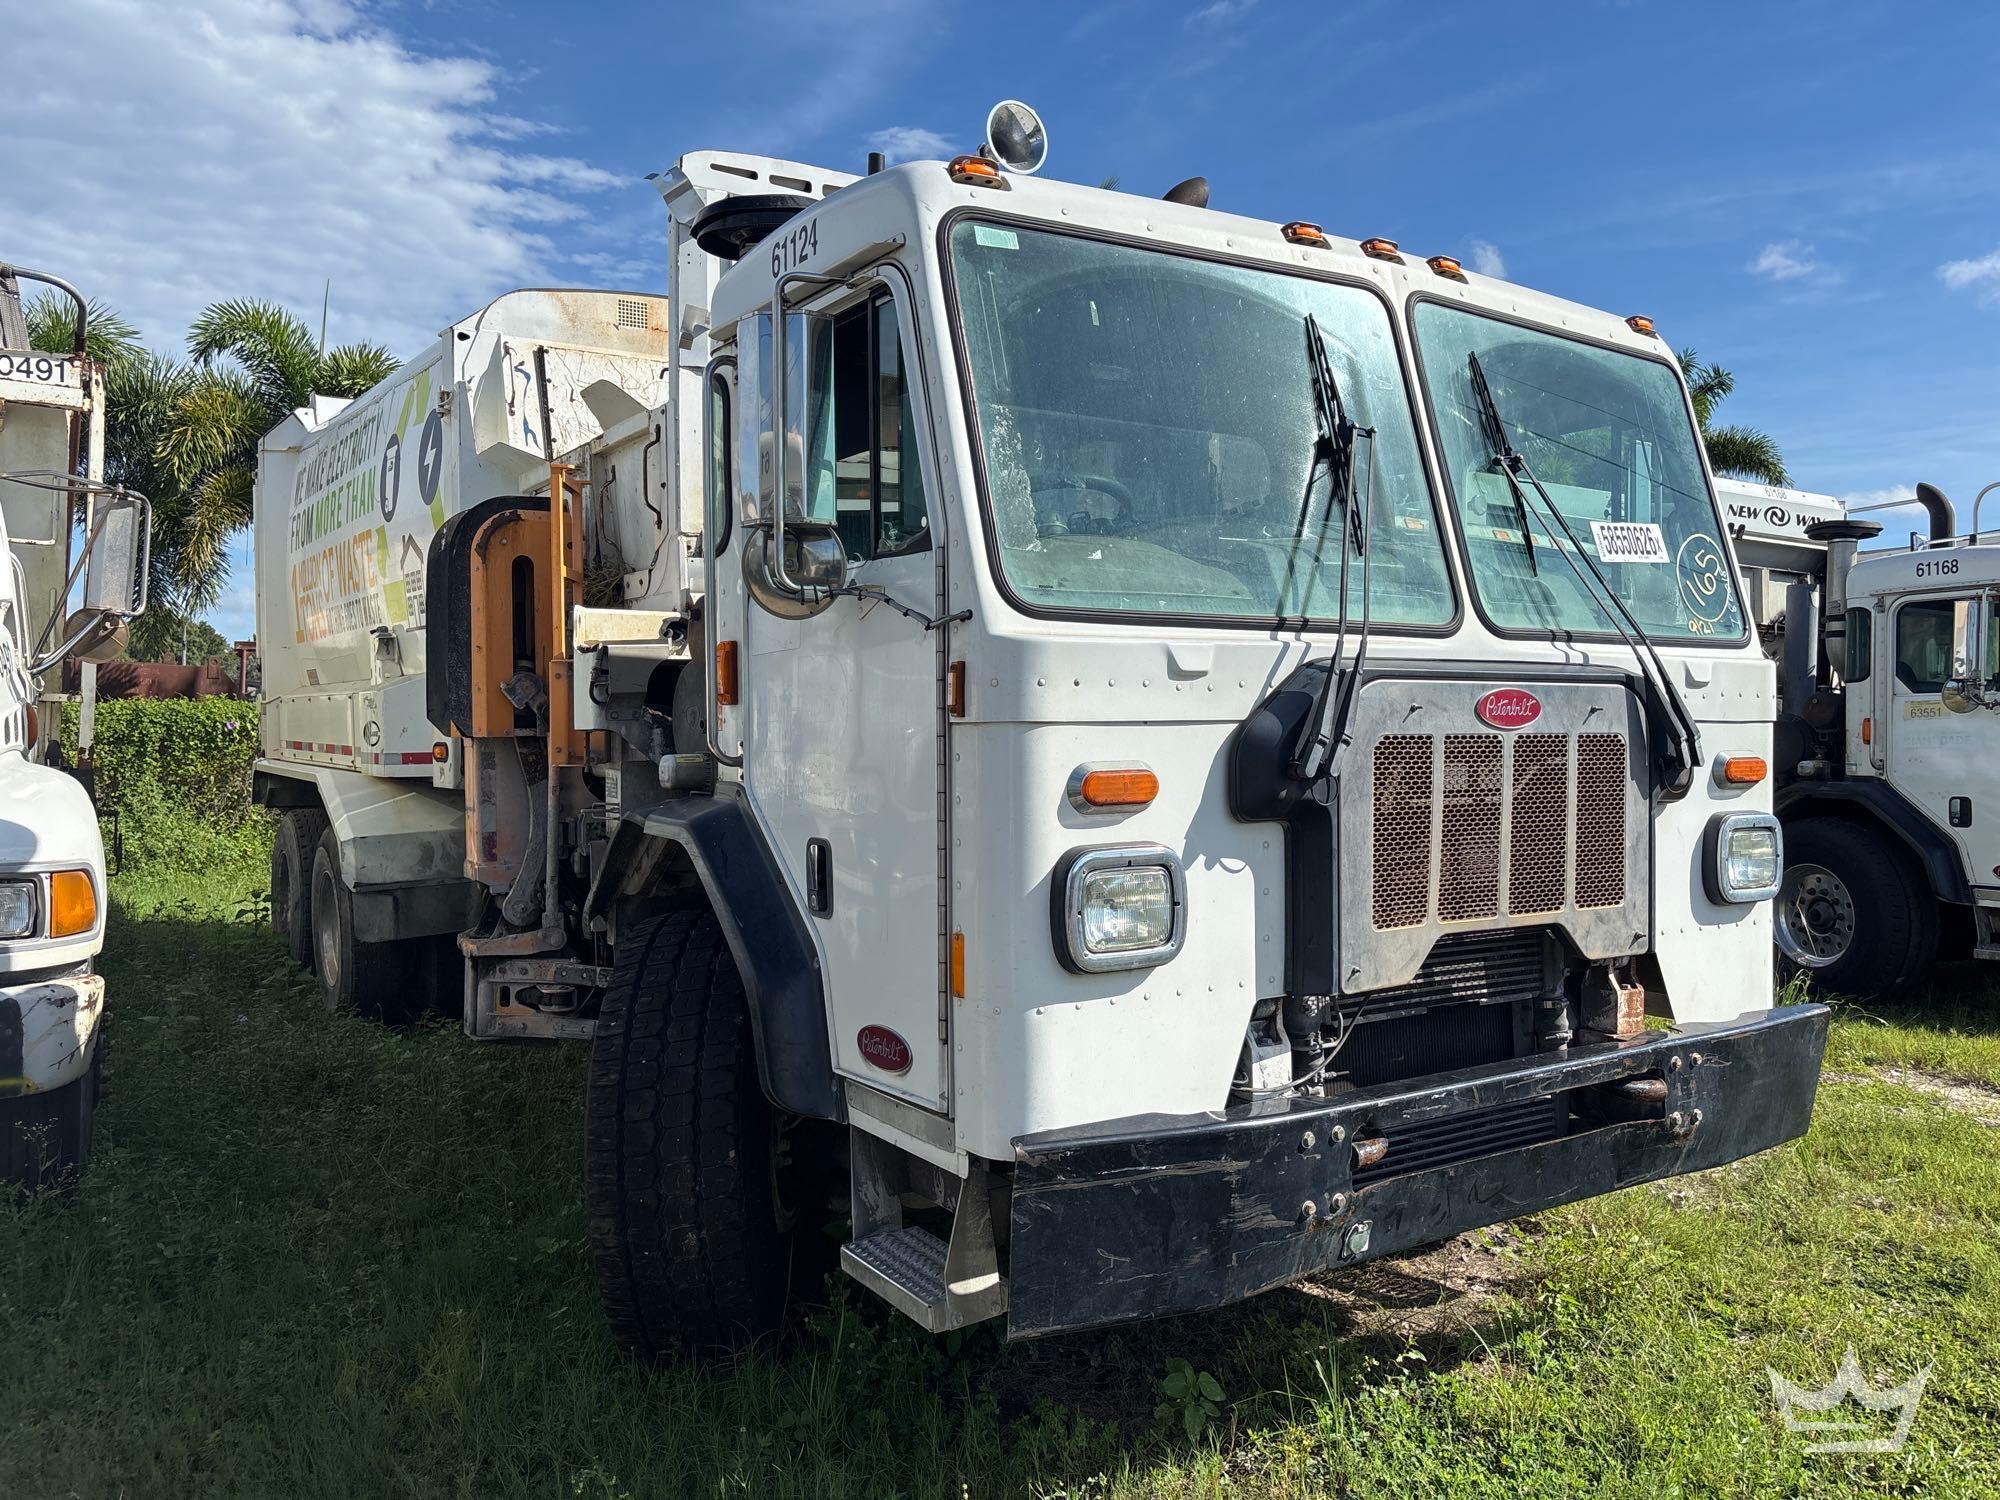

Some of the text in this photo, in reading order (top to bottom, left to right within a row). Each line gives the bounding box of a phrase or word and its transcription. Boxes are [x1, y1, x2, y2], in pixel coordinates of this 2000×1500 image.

[771, 218, 818, 279] 61124
[304, 449, 329, 500] MAKE
[326, 406, 384, 486] ELECTRICITY
[290, 465, 377, 554] FROM MORE THAN
[1727, 503, 1762, 519] NEW
[321, 546, 335, 603] OF
[1686, 549, 1720, 606] 165
[1915, 558, 1959, 578] 61168
[1688, 618, 1715, 637] 9/21
[1486, 695, 1537, 718] Peterbilt
[1910, 707, 1941, 719] 63551
[862, 1030, 904, 1061] Peterbilt
